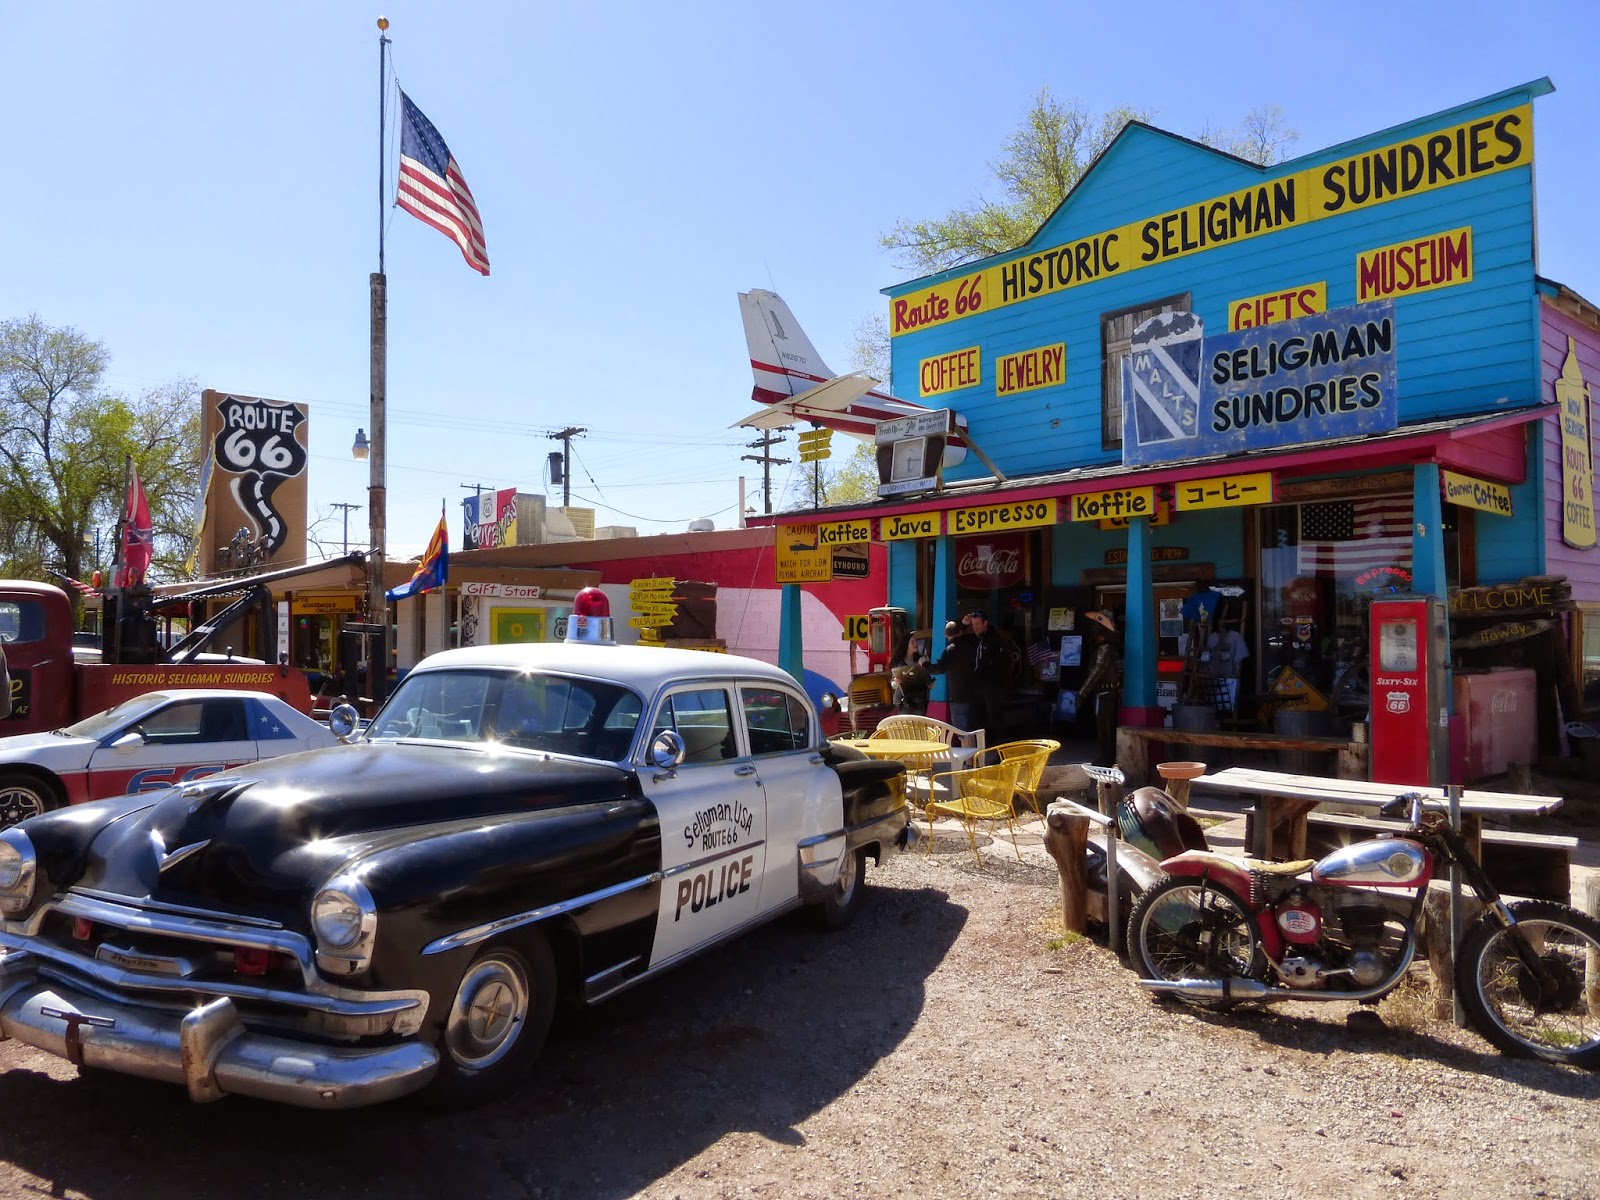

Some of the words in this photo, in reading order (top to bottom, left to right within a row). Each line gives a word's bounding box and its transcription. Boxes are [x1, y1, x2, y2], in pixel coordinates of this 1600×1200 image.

[895, 293, 949, 332] Route
[955, 275, 982, 315] 66
[1002, 234, 1120, 302] HISTORIC
[1141, 178, 1296, 262] SELIGMAN
[1323, 114, 1523, 212] SUNDRIES
[1359, 231, 1469, 300] MUSEUM
[1234, 288, 1317, 330] GIFTS
[1212, 318, 1392, 385] SELIGMAN
[921, 349, 977, 393] COFFEE
[998, 346, 1063, 392] JEWELRY
[1134, 354, 1195, 427] MALTS
[1212, 373, 1382, 432] SUNDRIES
[228, 404, 294, 433] ROUTE
[1567, 396, 1581, 417] NOW
[1564, 416, 1585, 441] SERVING
[224, 428, 293, 469] 66
[1565, 445, 1587, 475] ROUTE
[1186, 481, 1258, 504] コーヒー
[1447, 481, 1474, 498] Gourmet
[1473, 483, 1510, 512] Coffee
[1572, 474, 1584, 501] 66
[955, 502, 1048, 532] Espresso
[1076, 491, 1147, 519] Koffie
[1566, 500, 1591, 529] COFFEE
[786, 524, 817, 536] CAUTIO
[819, 523, 868, 544] Kaffee
[889, 517, 932, 537] Java
[779, 570, 797, 579] FLYING
[801, 569, 828, 578] AIRCRAFT
[780, 560, 797, 569] WATCH
[800, 559, 811, 567] FOR
[815, 558, 828, 567] LOW
[834, 560, 866, 571] EYHOUND
[1355, 566, 1412, 585] Espresso
[467, 583, 498, 595] Gift
[505, 586, 538, 597] Store
[848, 617, 868, 639] IC
[1480, 623, 1526, 645] Howdy
[112, 673, 166, 685] HISTORIC
[168, 673, 222, 685] SELIGMAN
[224, 672, 275, 684] SUNDRIES
[1156, 688, 1179, 698] ELEVAT
[1389, 700, 1406, 710] 66
[15, 705, 29, 714] AZ
[734, 799, 753, 837] USA
[702, 830, 727, 852] ROUTE
[726, 826, 738, 845] 66
[674, 854, 754, 923] POLICE
